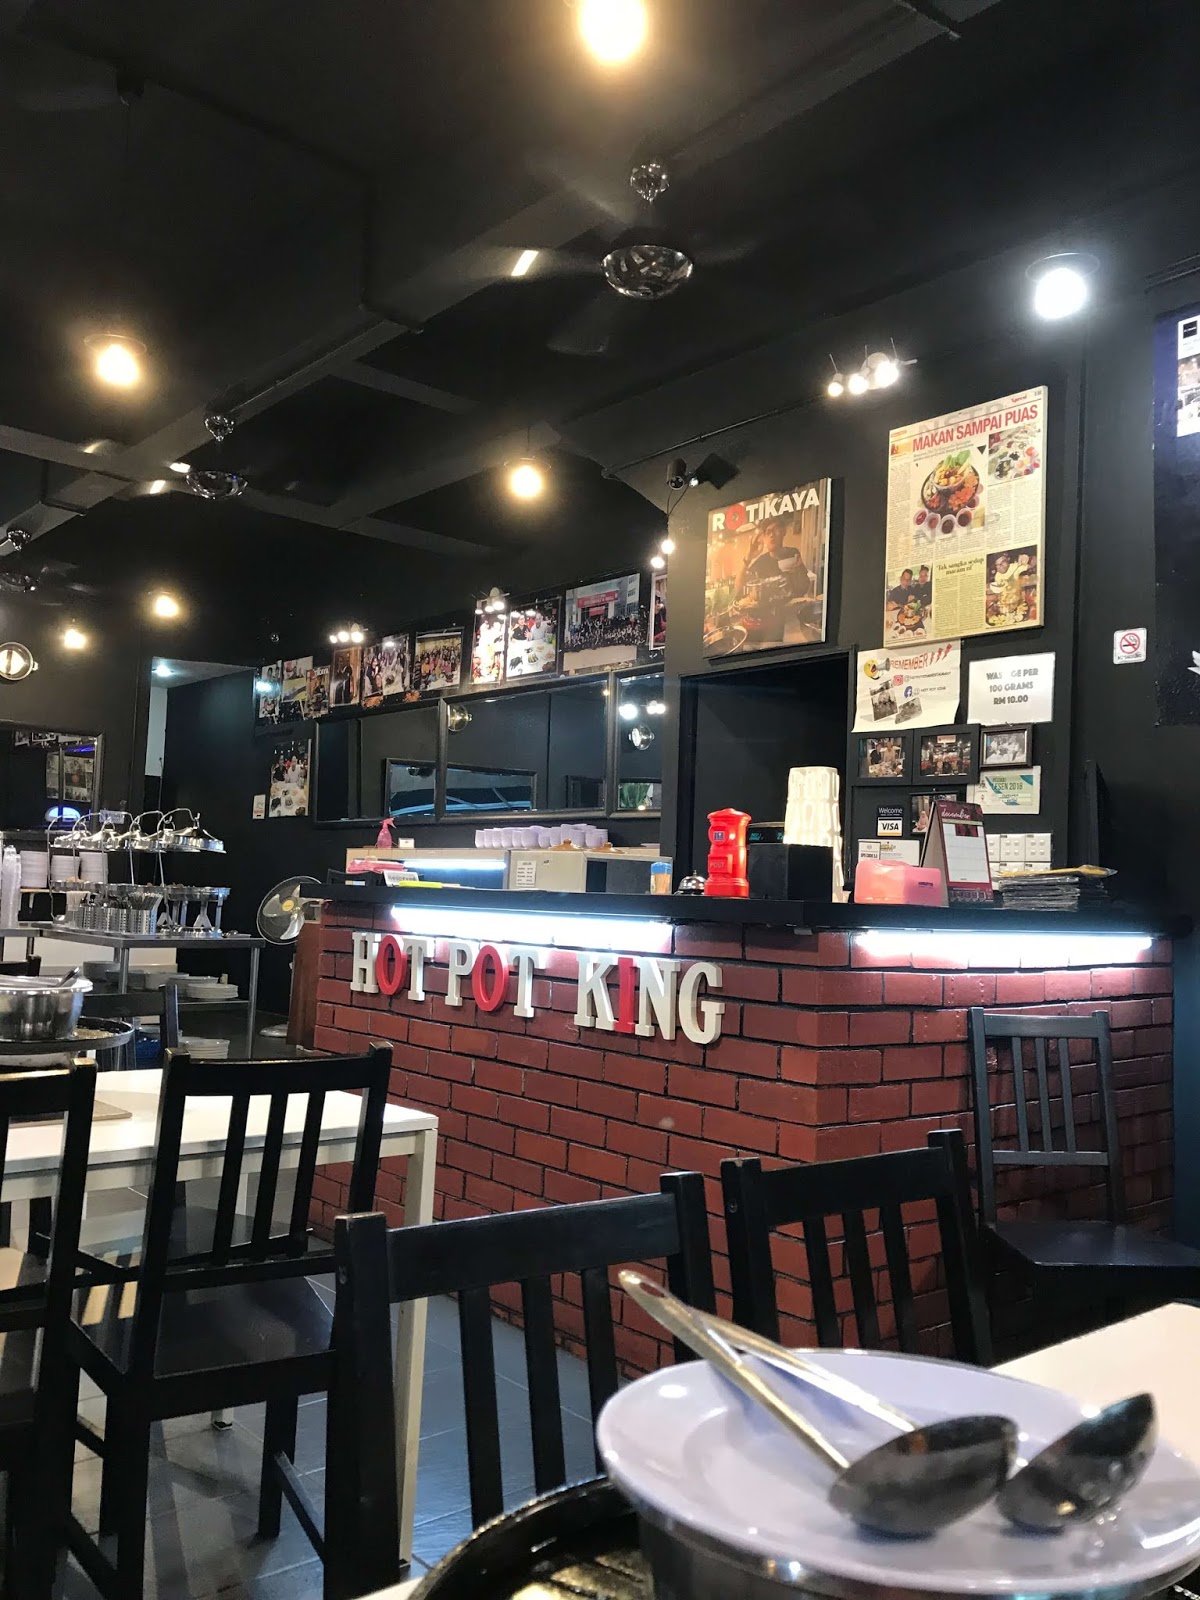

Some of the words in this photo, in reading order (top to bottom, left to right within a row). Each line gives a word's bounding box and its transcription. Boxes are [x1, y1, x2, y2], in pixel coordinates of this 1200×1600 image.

[913, 428, 954, 452] MAKAN
[956, 412, 1003, 440] SAMPAI
[1005, 404, 1038, 426] PUAS
[712, 488, 820, 531] ROTIKAYA
[890, 652, 929, 670] REMEMBER
[986, 669, 1021, 680] WASGE
[1023, 668, 1038, 677] PER
[989, 684, 1003, 693] 100
[1004, 681, 1033, 691] GRAMS
[993, 697, 1006, 705] RM
[1007, 694, 1029, 704] 10.00
[881, 823, 899, 831] VISA
[350, 932, 434, 1001] HOT
[445, 937, 547, 1018] POT
[574, 952, 725, 1045] KING
